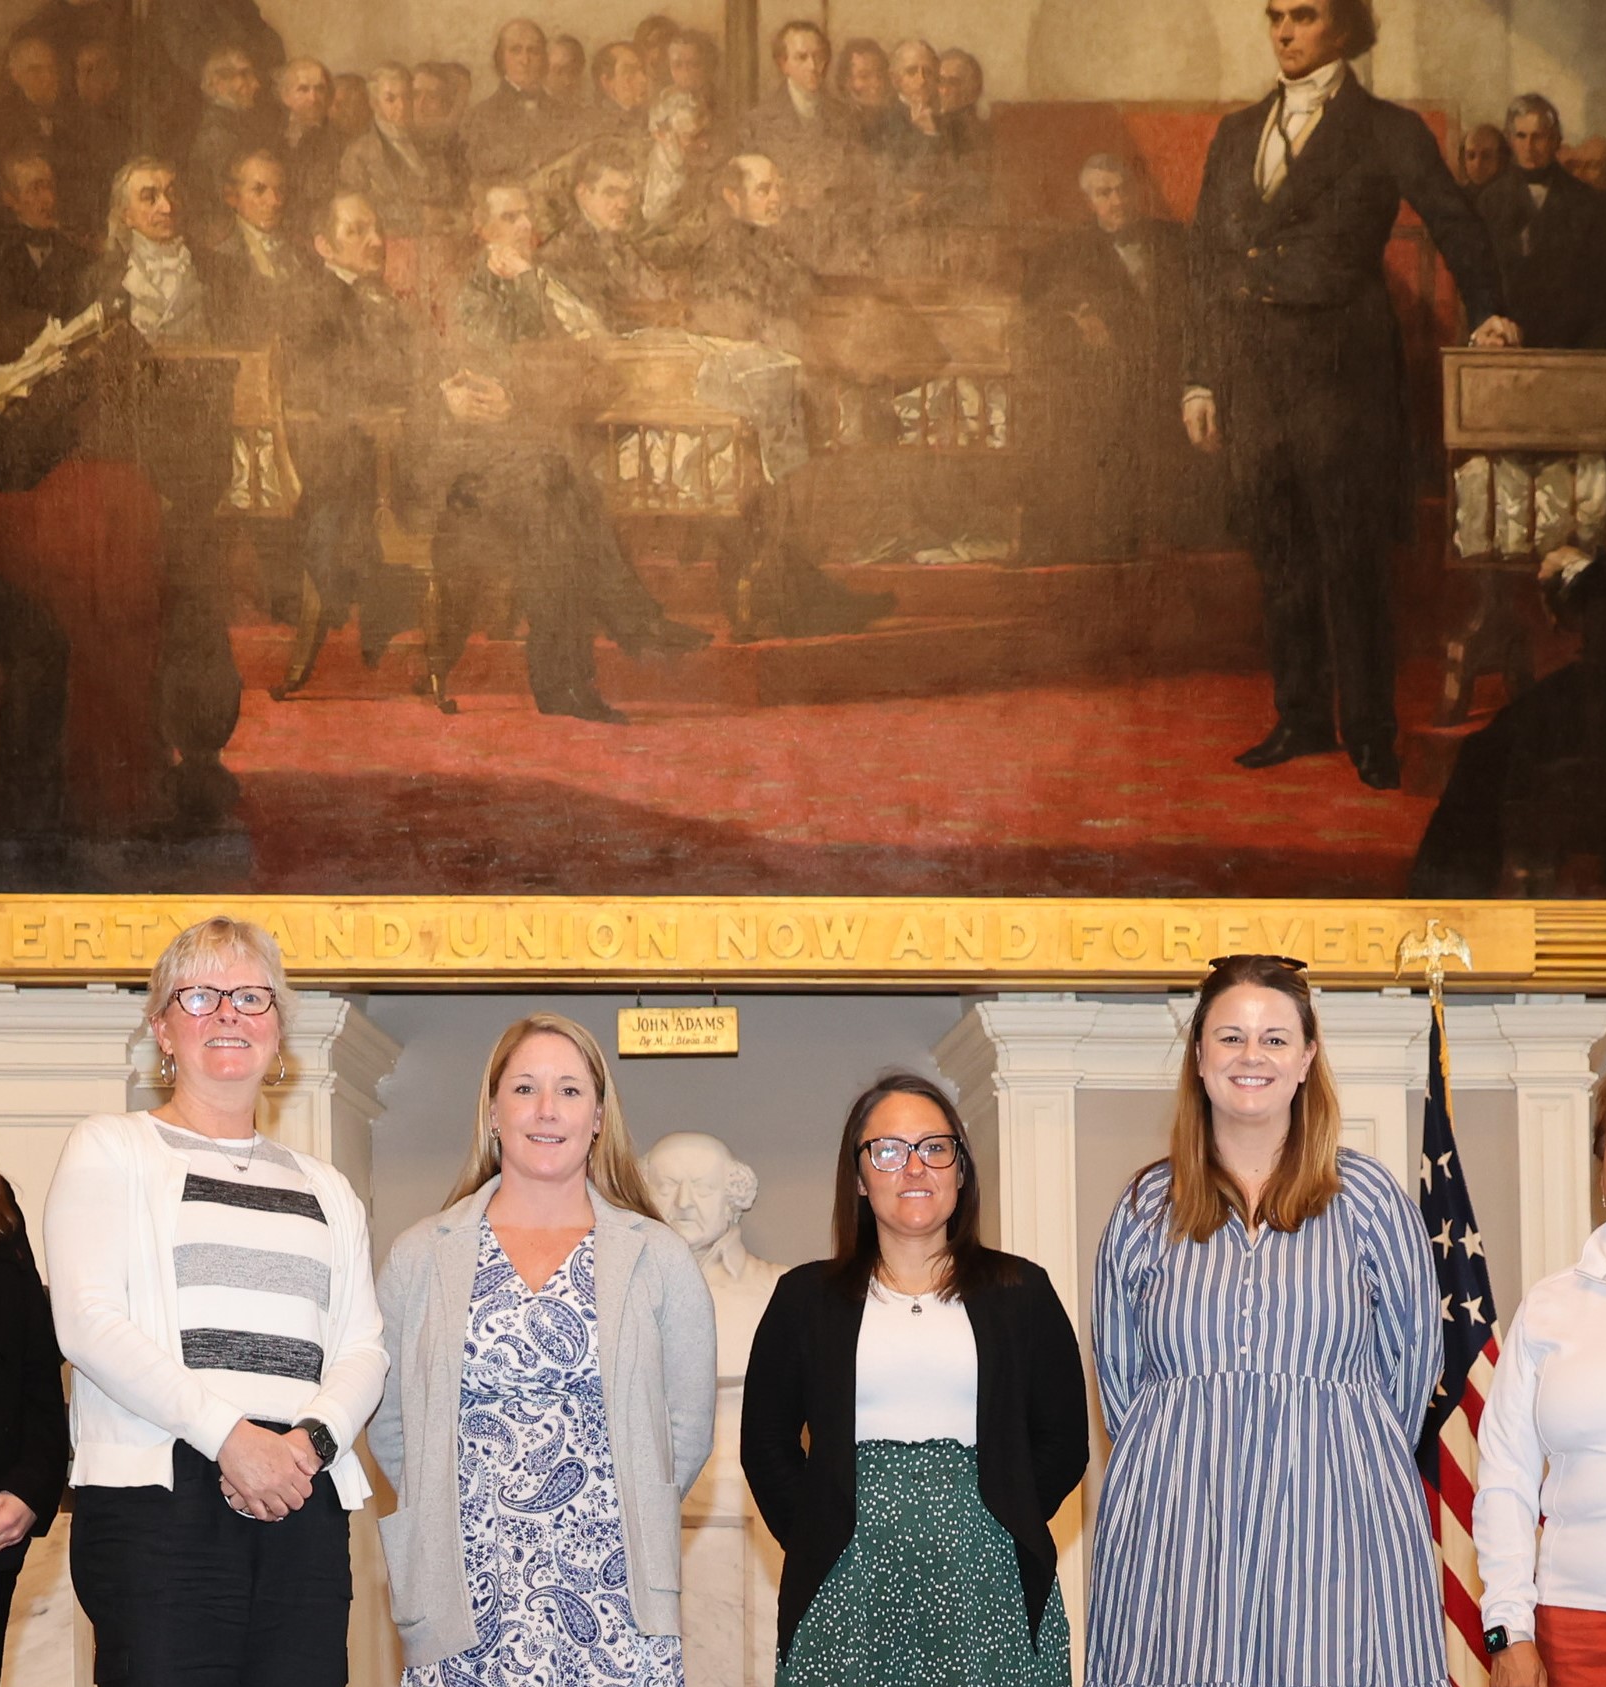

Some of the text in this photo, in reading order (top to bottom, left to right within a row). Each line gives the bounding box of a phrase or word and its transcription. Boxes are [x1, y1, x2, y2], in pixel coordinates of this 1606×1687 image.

[448, 914, 679, 960] UNION
[717, 914, 866, 960] NOW
[891, 915, 1038, 961] AND
[1071, 916, 1394, 962] FOREVER
[632, 1016, 725, 1032] JOHN ADAMS
